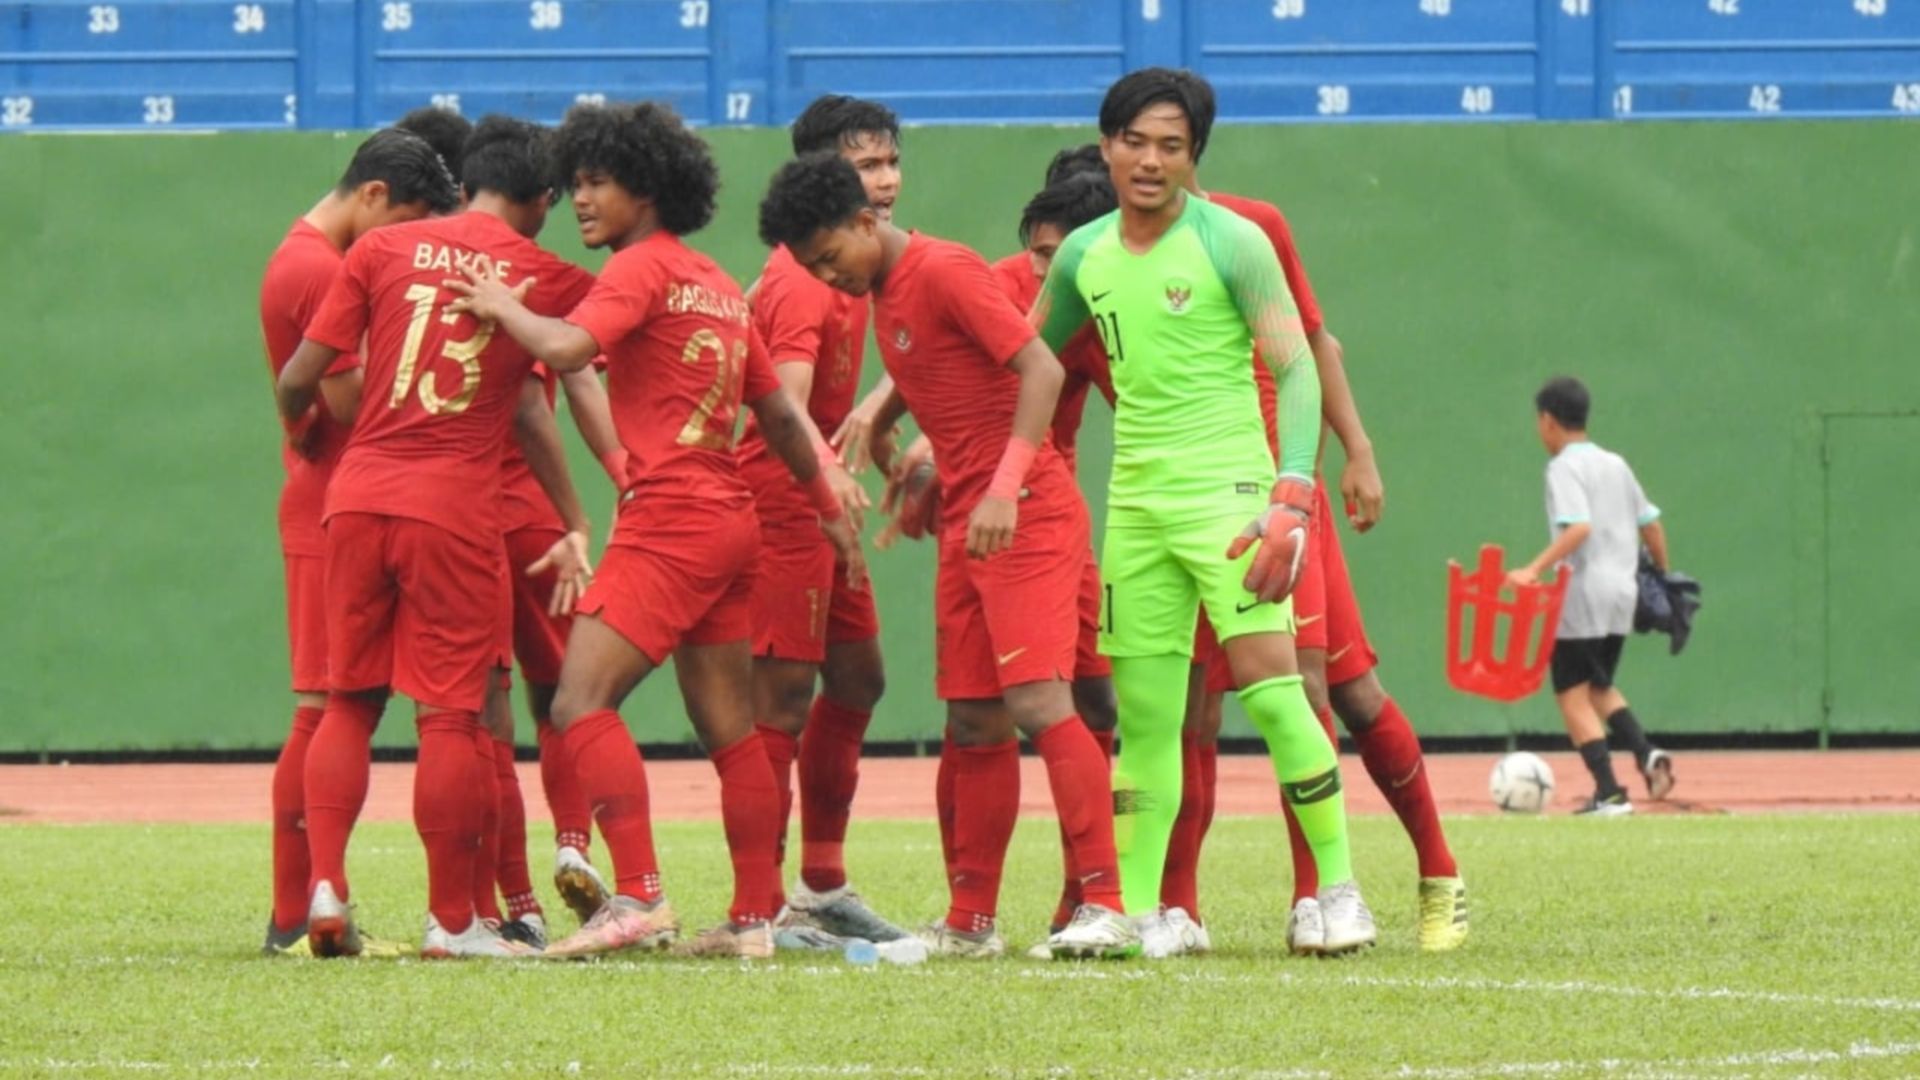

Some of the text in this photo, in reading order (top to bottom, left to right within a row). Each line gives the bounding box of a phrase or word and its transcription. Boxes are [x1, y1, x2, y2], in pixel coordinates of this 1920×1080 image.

[89, 6, 119, 33] 33
[233, 5, 264, 32] 34
[382, 3, 412, 30] 35
[530, 0, 562, 29] 36
[680, 0, 709, 27] 37
[2, 97, 32, 125] 32
[144, 97, 174, 123] 33
[1318, 86, 1349, 114] 39
[1461, 87, 1492, 112] 40
[1749, 86, 1780, 112] 42
[1892, 84, 1920, 111] 43
[389, 283, 496, 415] 13
